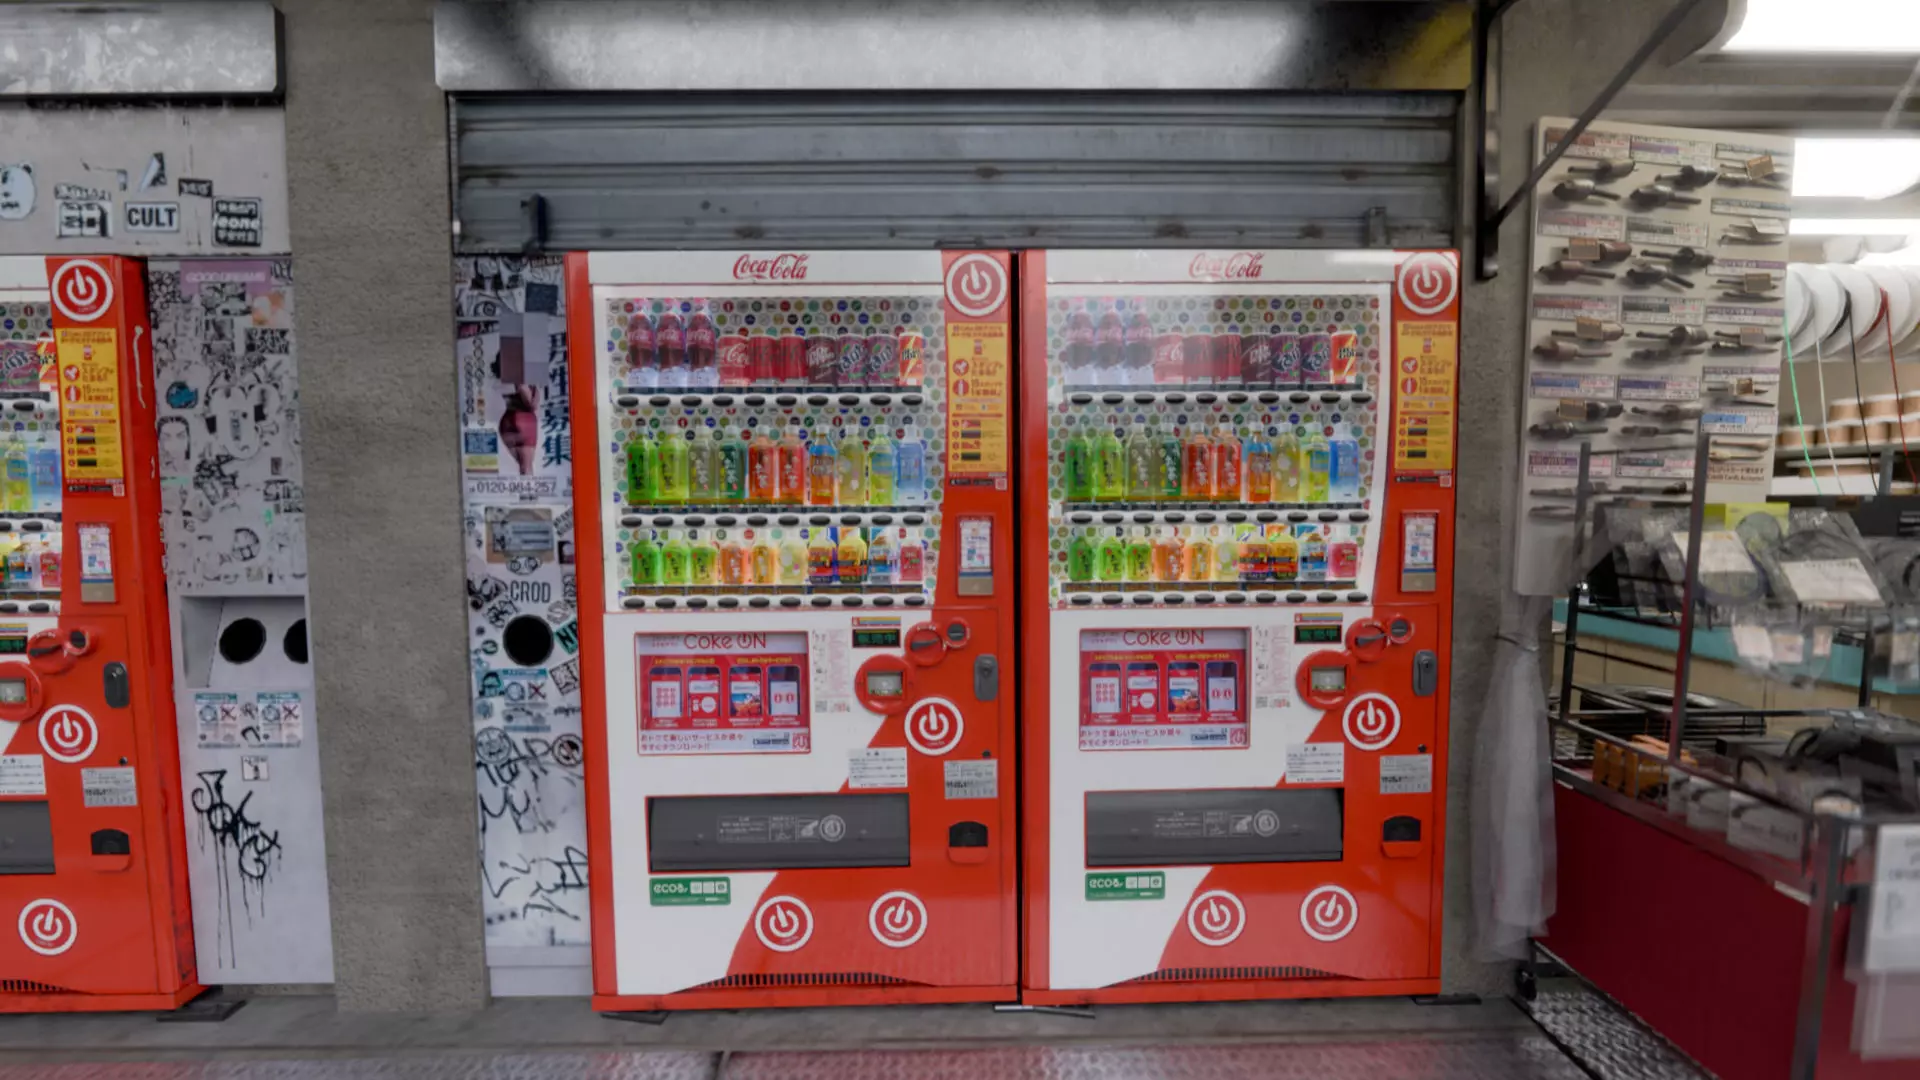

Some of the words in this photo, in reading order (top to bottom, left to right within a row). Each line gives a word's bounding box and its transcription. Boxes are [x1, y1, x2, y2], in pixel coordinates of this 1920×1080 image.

[128, 208, 177, 227] CULT
[732, 253, 810, 280] Coca-Cola
[1188, 252, 1265, 279] Coca-Cola
[510, 580, 551, 603] CROD
[684, 633, 733, 649] Coke
[1122, 630, 1171, 646] Coke
